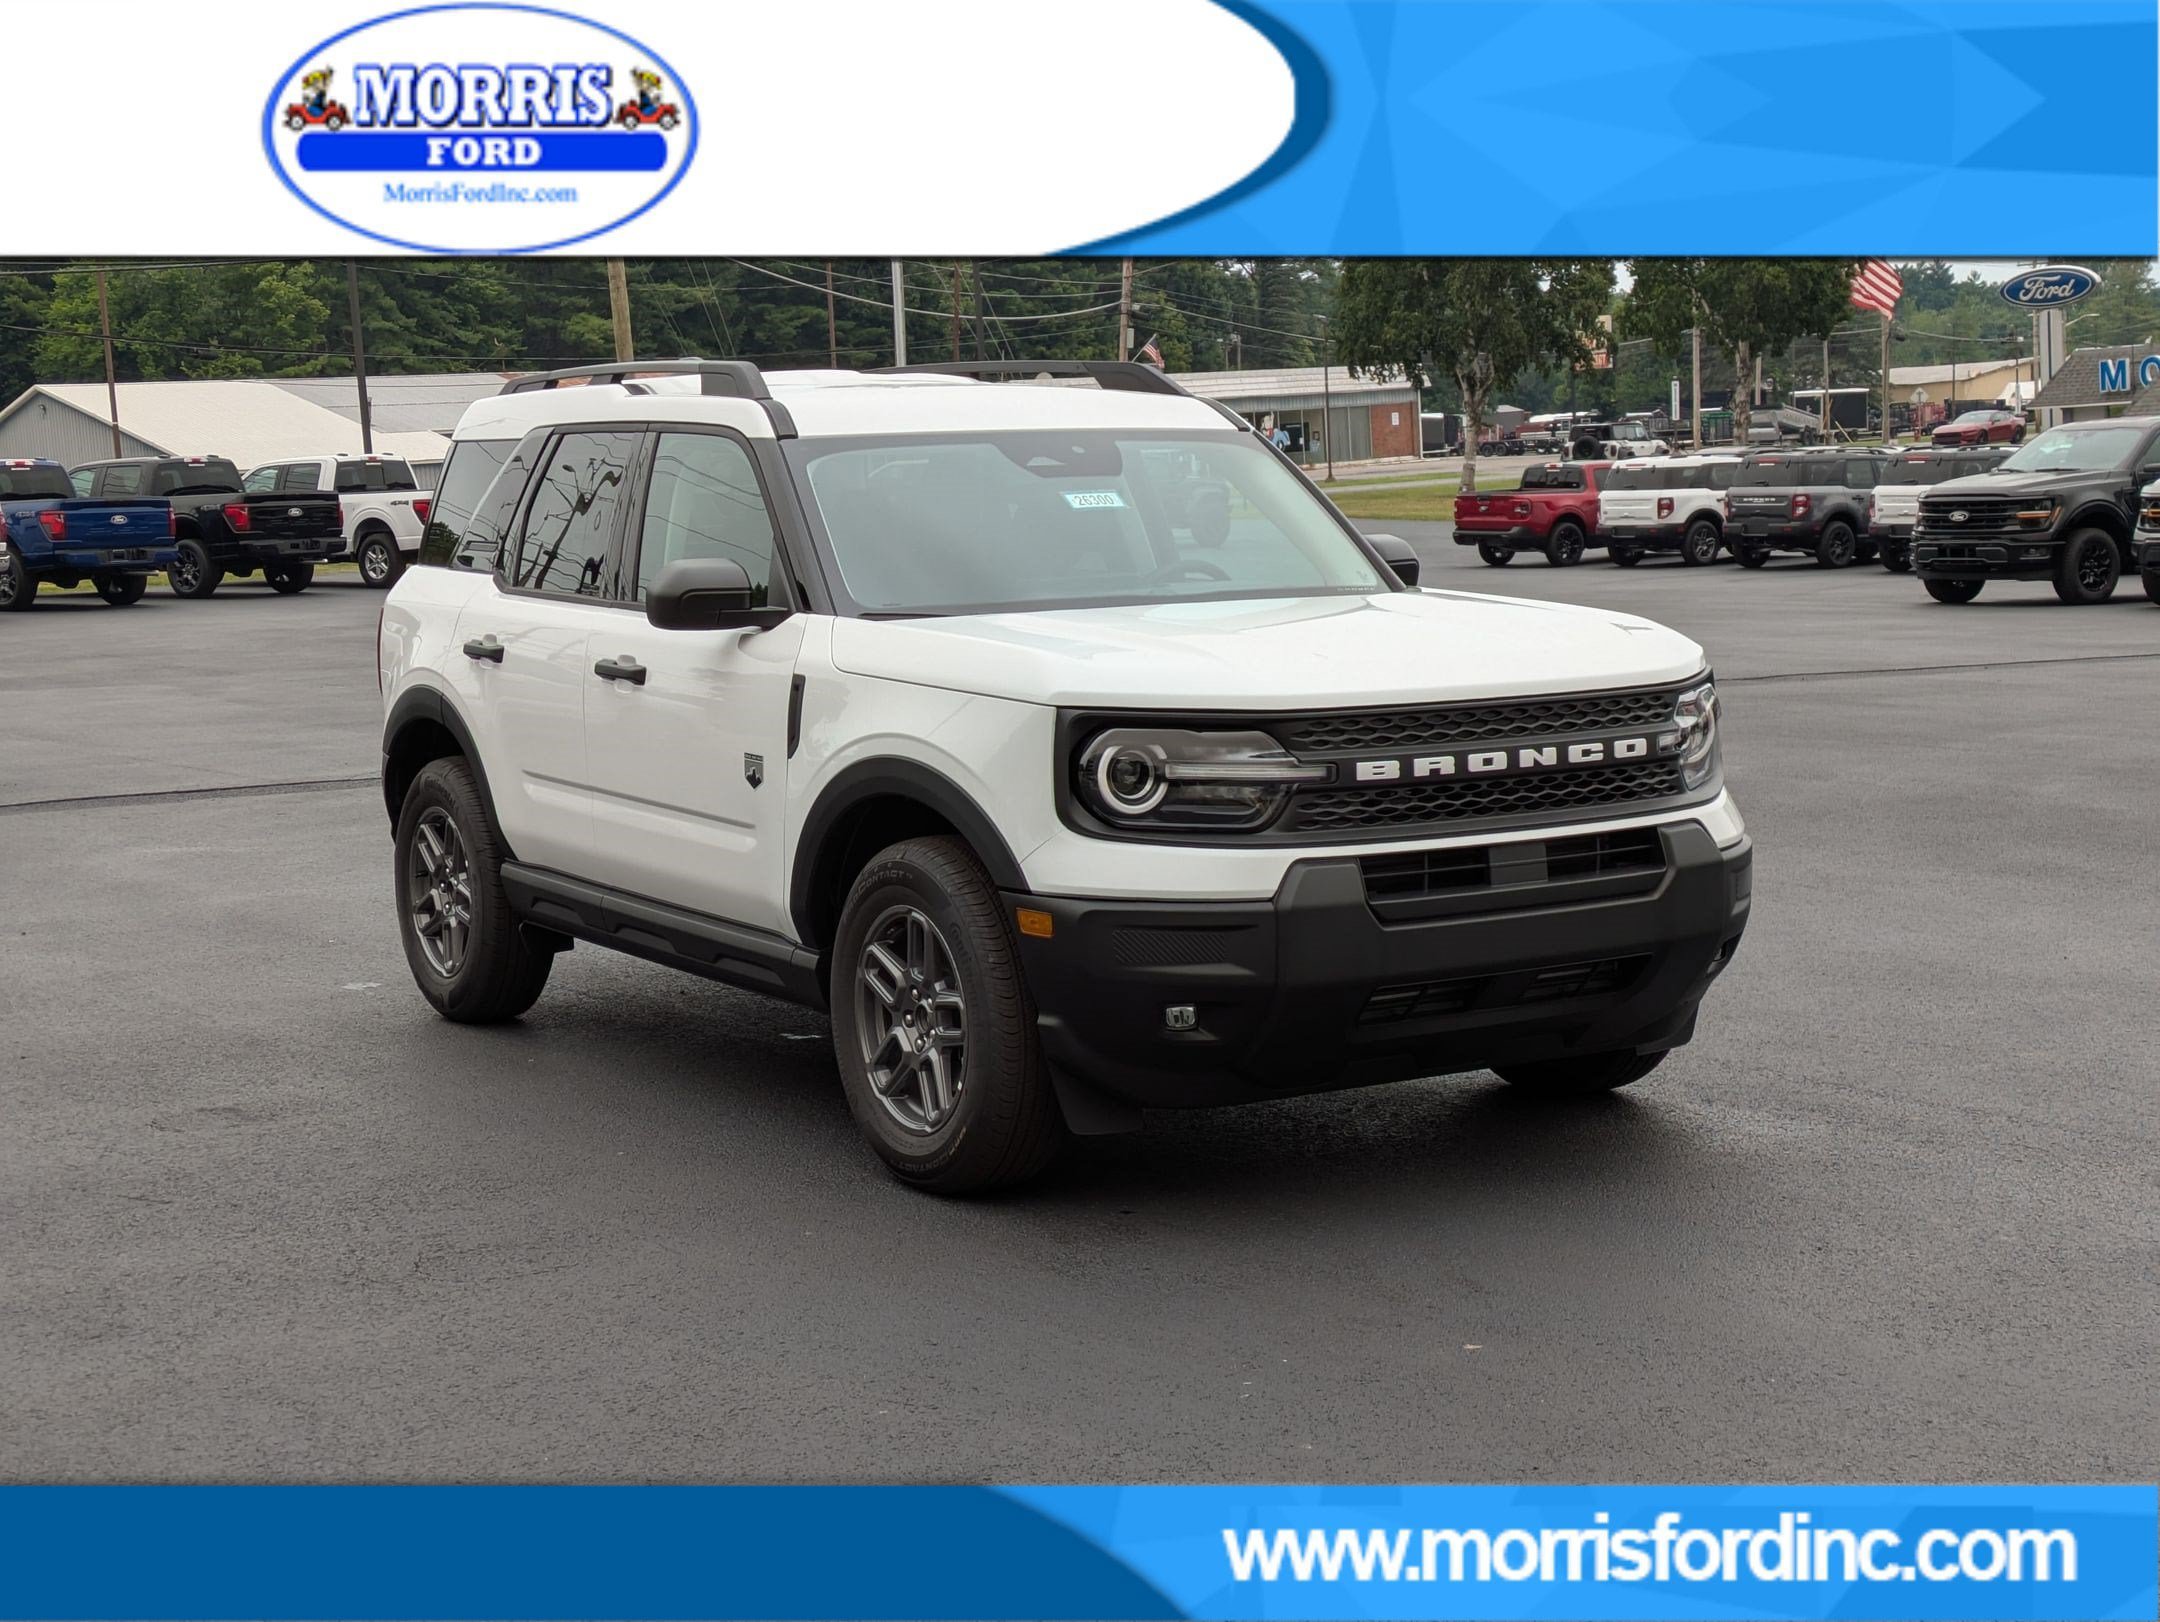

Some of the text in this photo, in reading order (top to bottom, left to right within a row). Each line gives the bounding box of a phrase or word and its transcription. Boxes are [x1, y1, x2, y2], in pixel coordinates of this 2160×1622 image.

[2019, 275, 2075, 301] Ford
[1073, 494, 1116, 506] 26300
[1355, 737, 1648, 782] BRONCO
